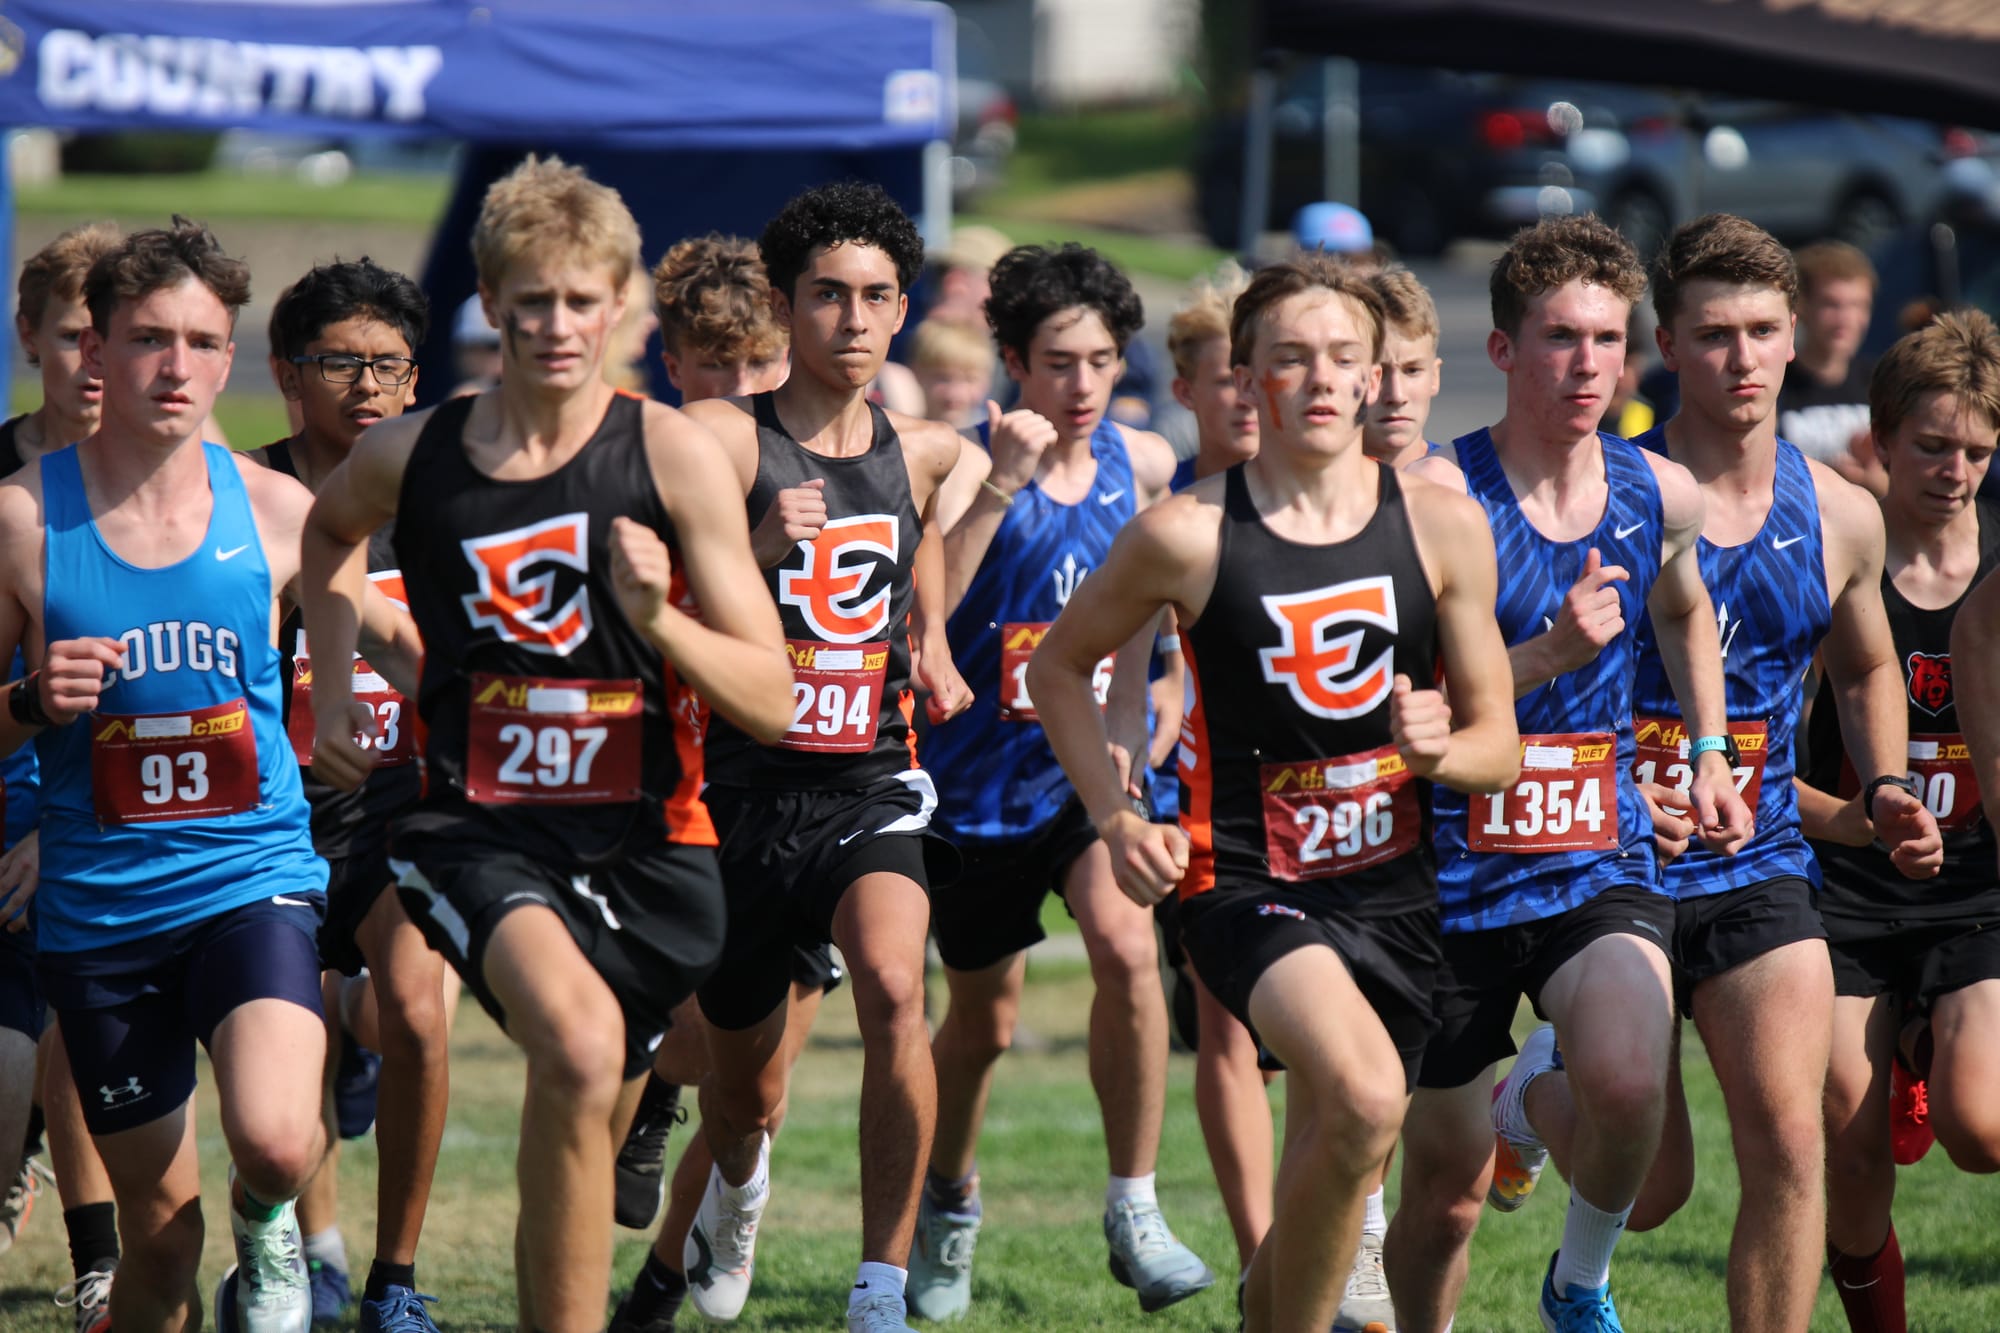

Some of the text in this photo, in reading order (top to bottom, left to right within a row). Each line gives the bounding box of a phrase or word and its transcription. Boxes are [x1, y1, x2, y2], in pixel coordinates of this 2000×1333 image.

[38, 28, 443, 121] COUNTRY
[212, 715, 241, 732] NET
[786, 682, 871, 736] 294
[497, 723, 608, 787] 297
[1581, 748, 1605, 759] NET
[1738, 737, 1761, 748] NET
[141, 751, 210, 804] 93
[1294, 791, 1394, 863] 296
[1483, 777, 1606, 836] 1354
